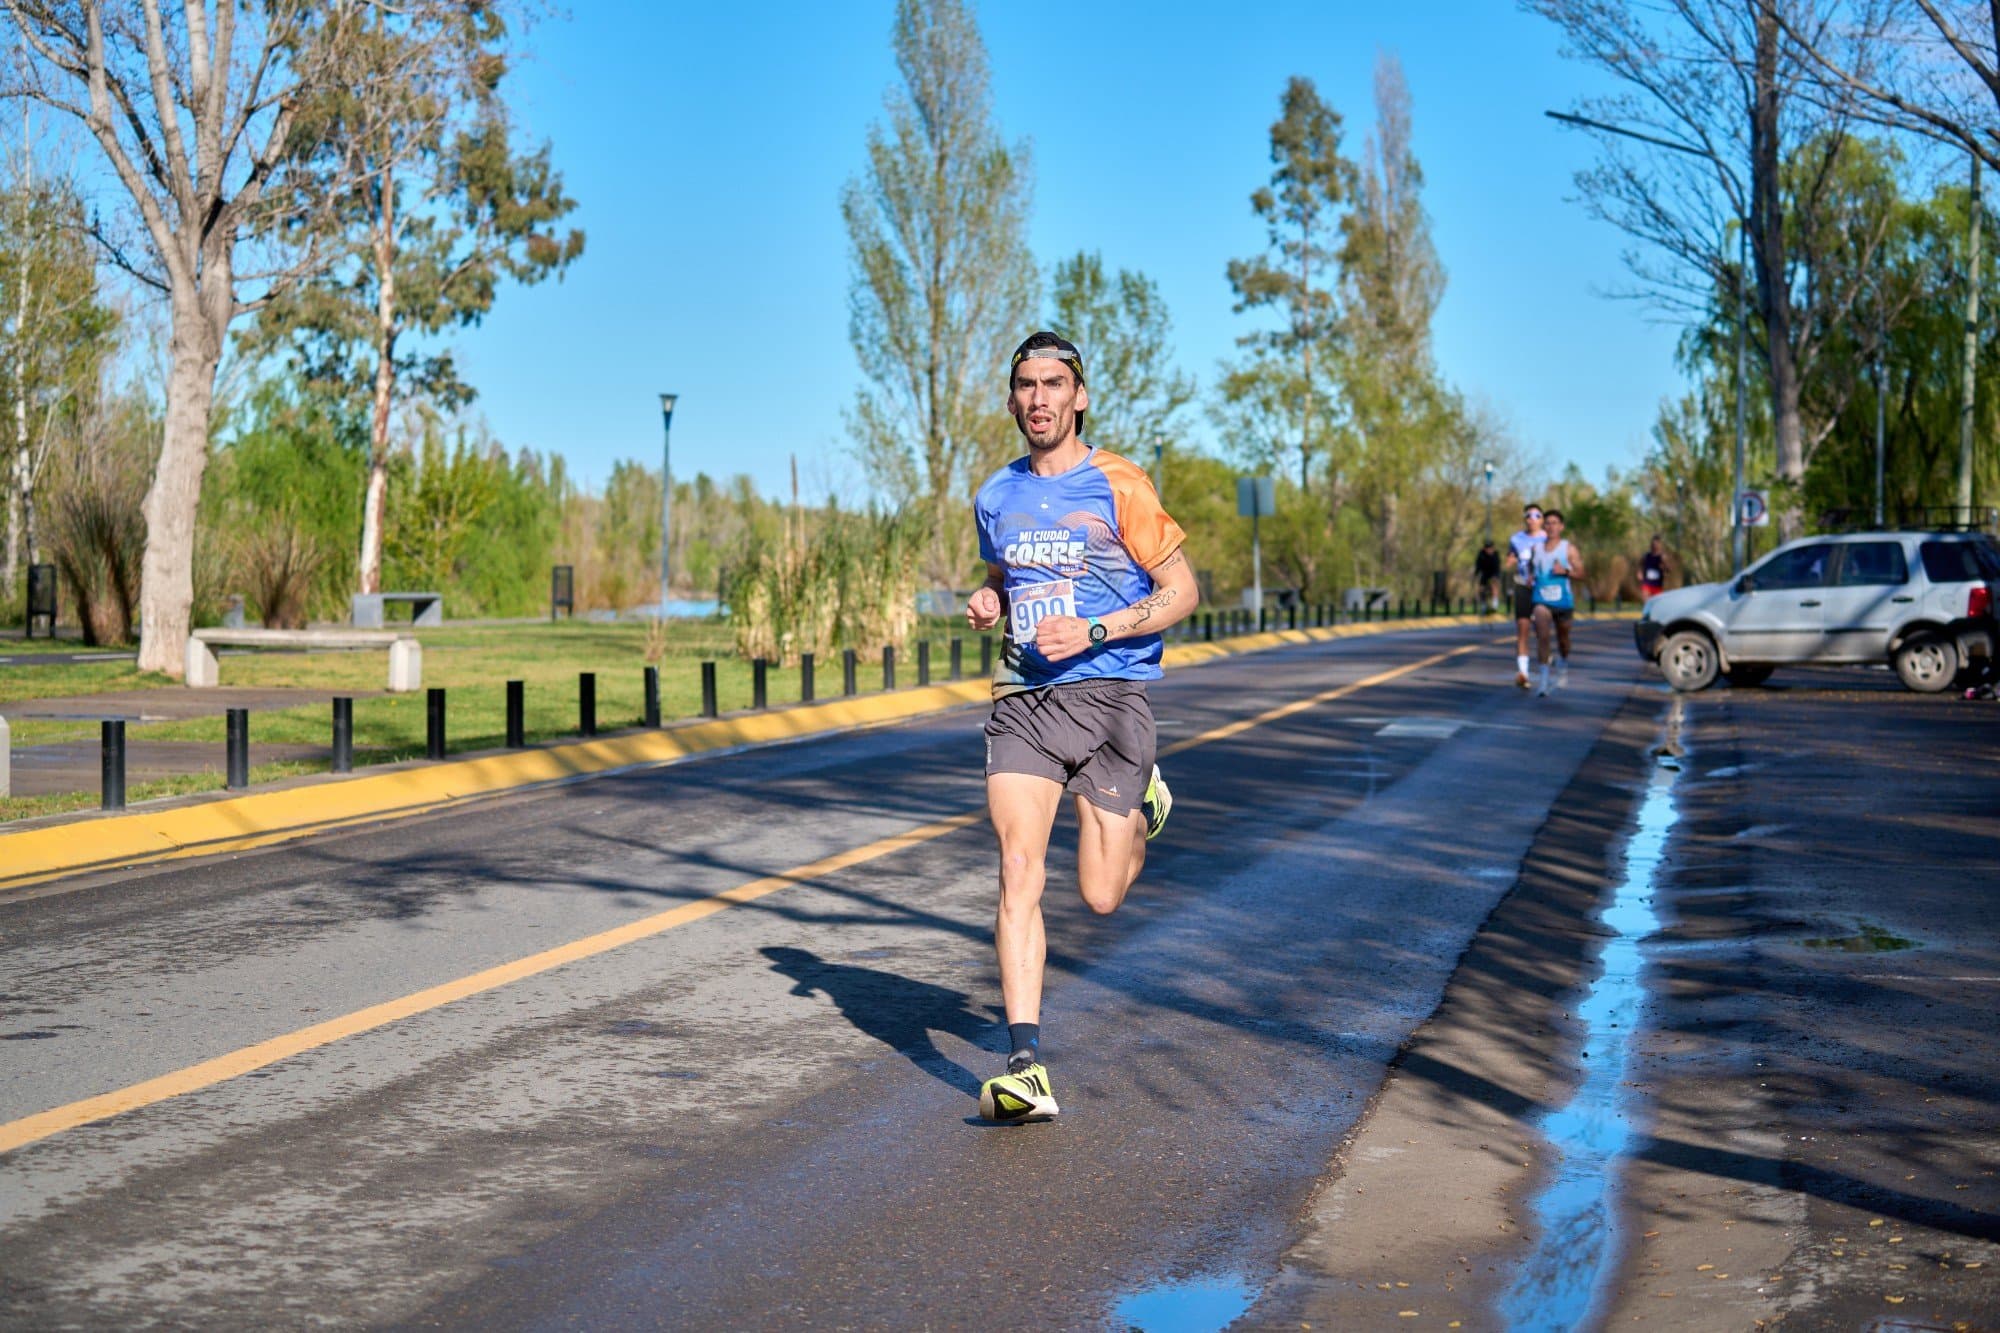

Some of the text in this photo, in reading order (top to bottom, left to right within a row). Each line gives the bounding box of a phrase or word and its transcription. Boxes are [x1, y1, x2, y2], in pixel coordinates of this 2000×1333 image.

[1019, 530, 1070, 542] MI CIUDAD
[1005, 542, 1084, 565] CORRE
